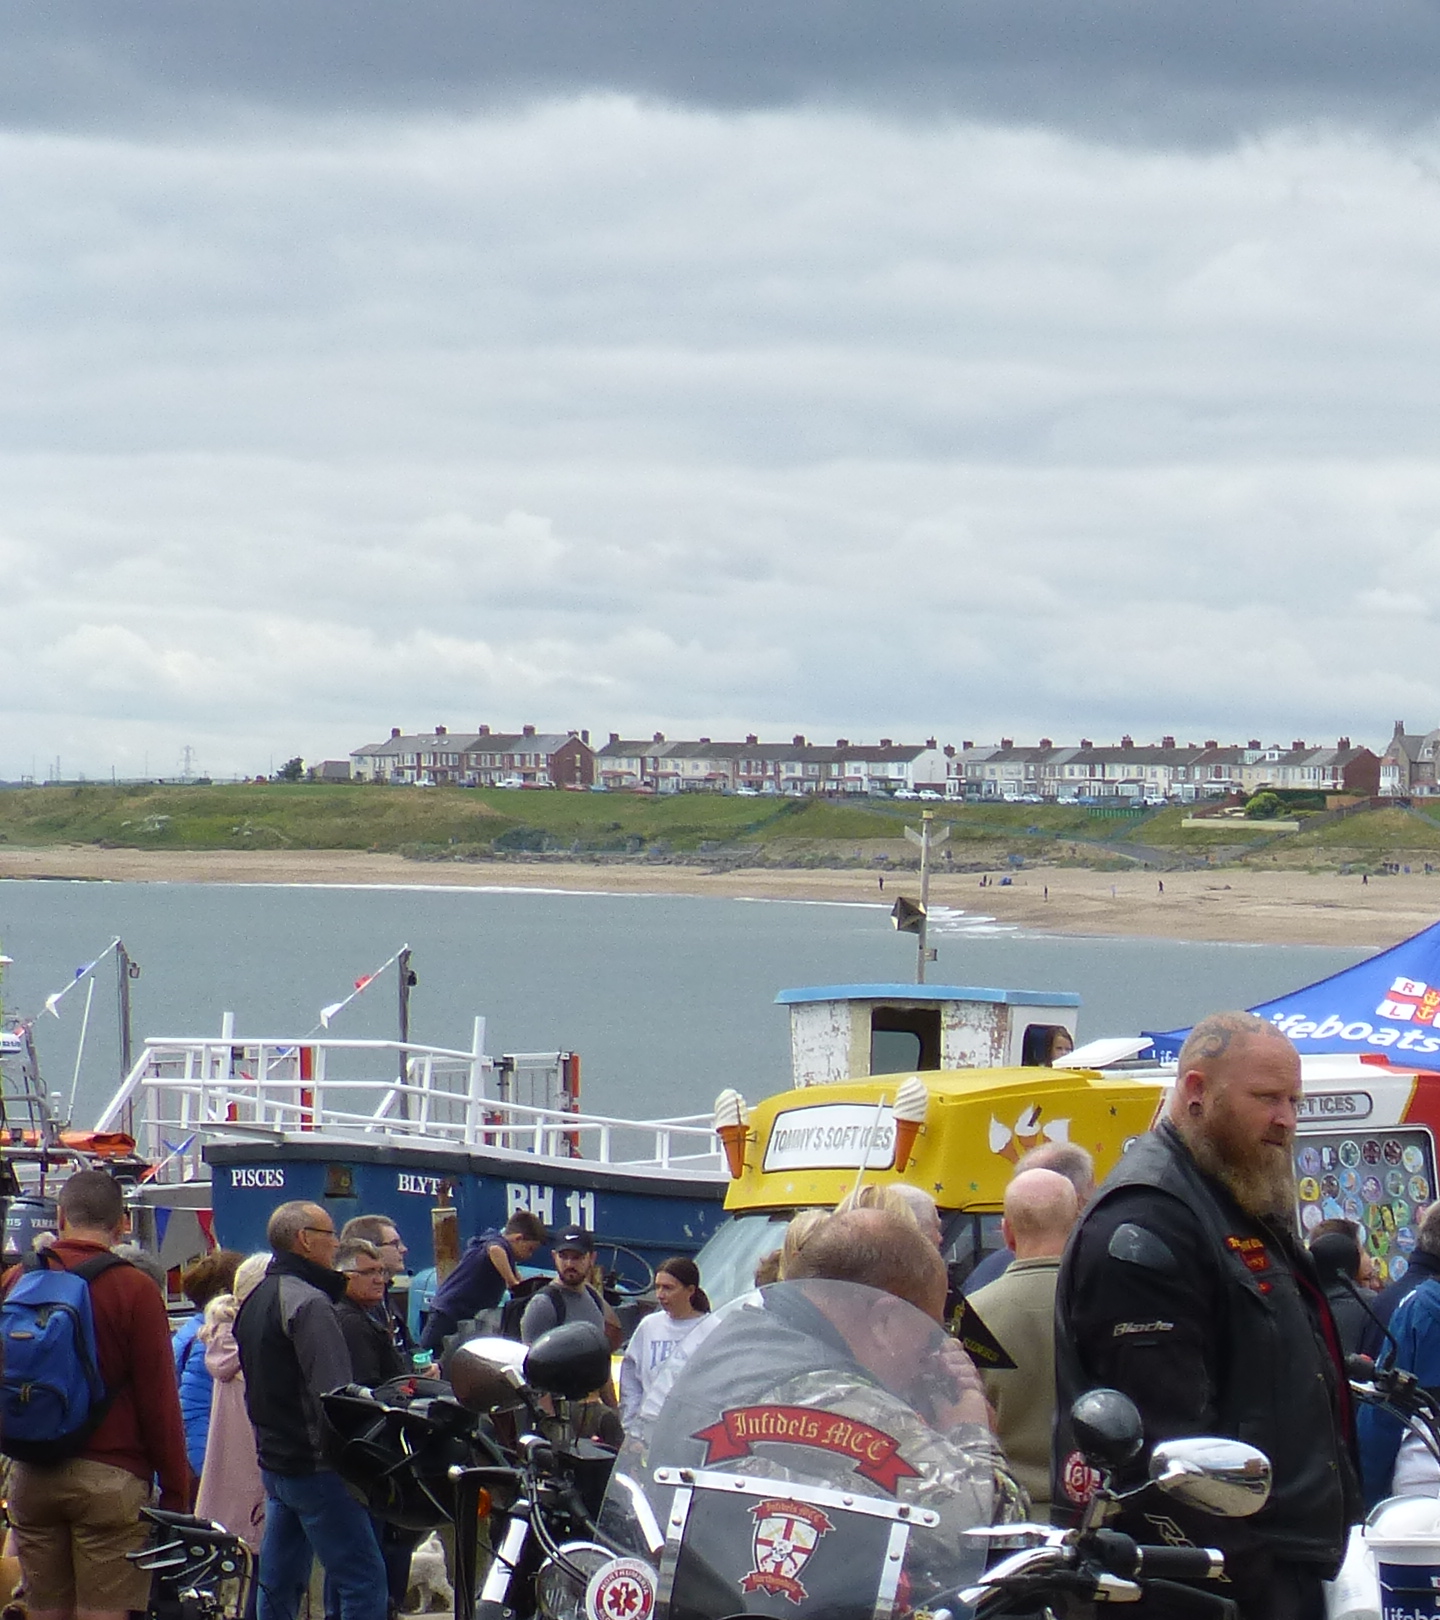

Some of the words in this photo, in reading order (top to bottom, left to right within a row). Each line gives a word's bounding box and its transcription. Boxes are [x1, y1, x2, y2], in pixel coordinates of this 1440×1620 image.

[1319, 1096, 1356, 1114] ICES
[773, 1126, 824, 1154] TOMMY'S
[824, 1126, 859, 1151] SOFT
[231, 1168, 285, 1188] PISCES
[506, 1183, 553, 1226] BH
[566, 1190, 595, 1232] 11
[733, 1412, 820, 1438] Infidels
[822, 1421, 889, 1461] MCC
